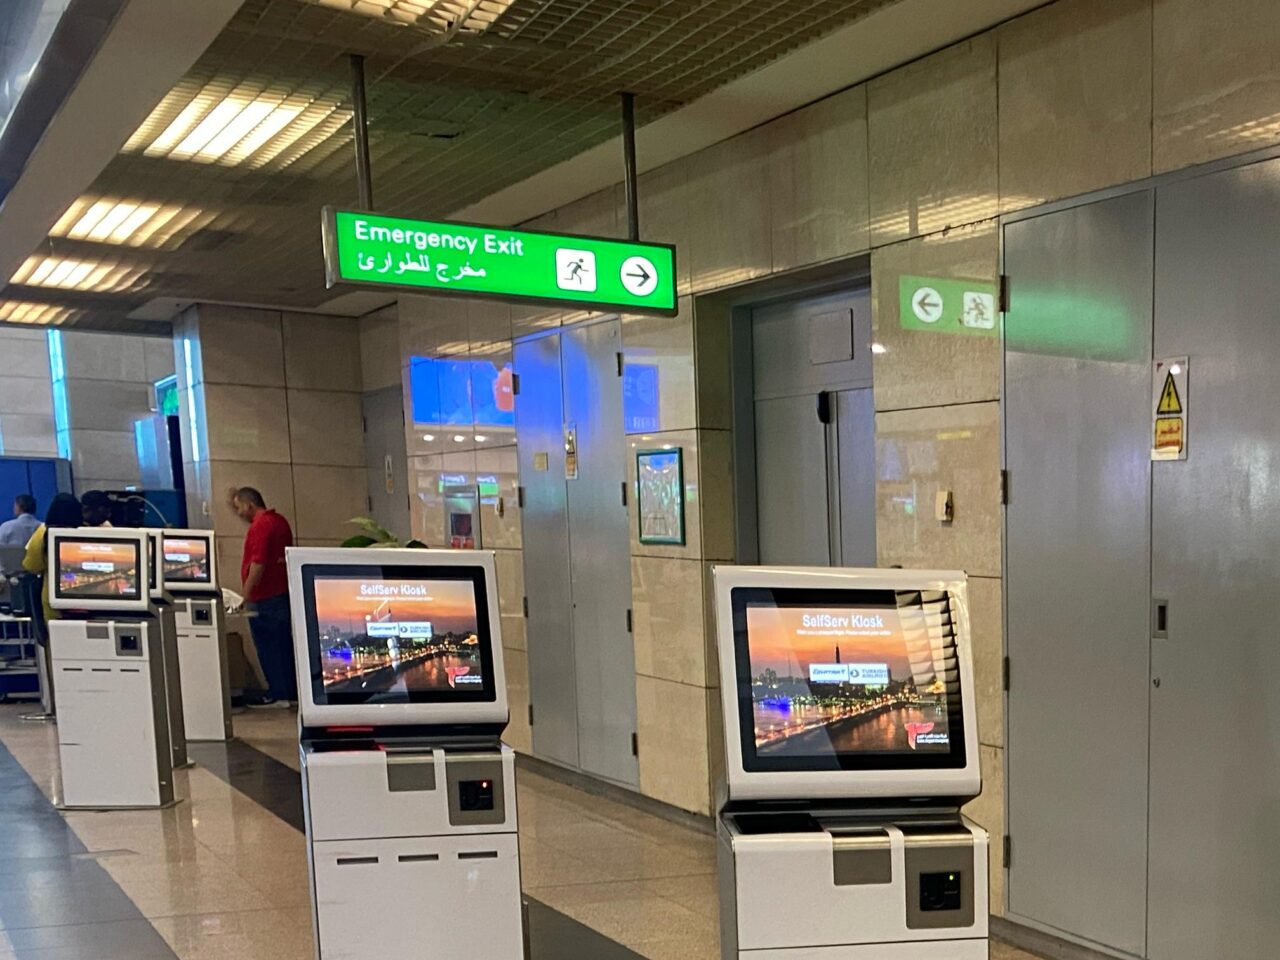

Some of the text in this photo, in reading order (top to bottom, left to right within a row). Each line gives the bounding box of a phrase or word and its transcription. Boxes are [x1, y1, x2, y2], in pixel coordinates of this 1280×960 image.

[354, 219, 524, 256] Emergency Exit
[357, 252, 487, 283] مخرج للطوارئ
[360, 584, 427, 596] SelfServ Kiosk
[802, 614, 884, 628] SelfServ Kiosk
